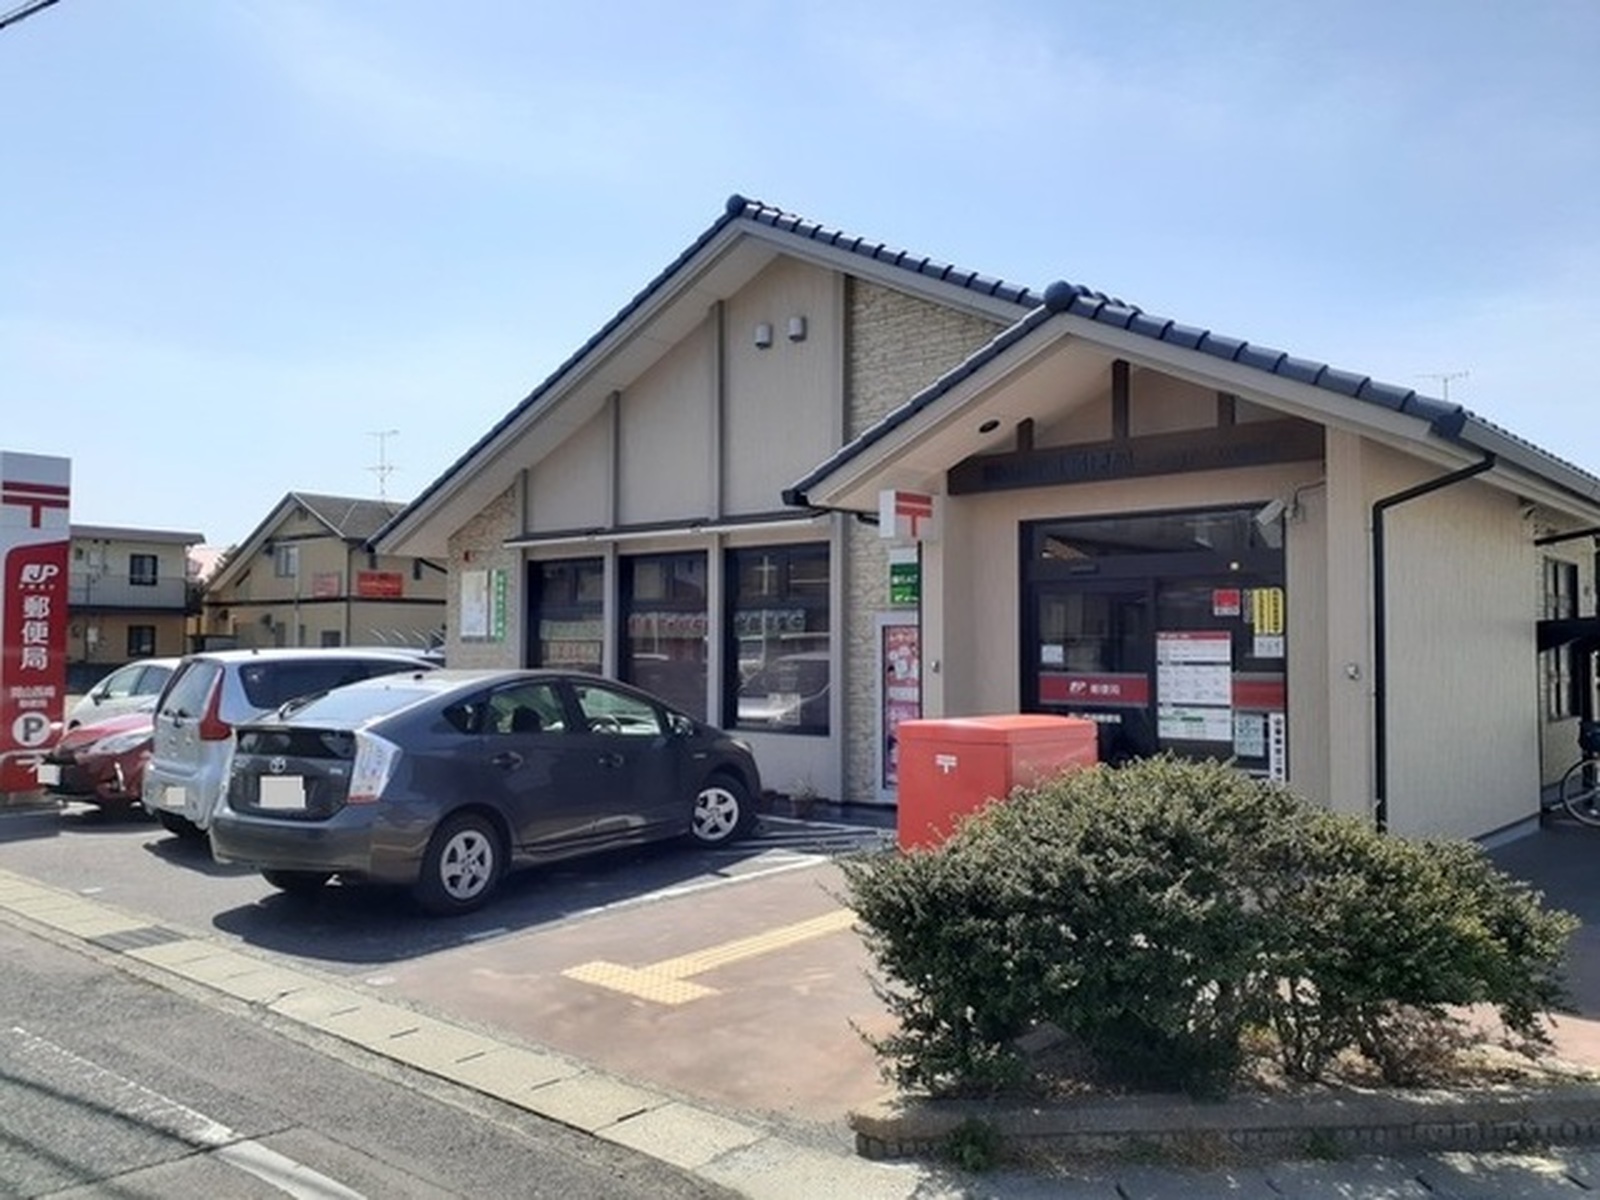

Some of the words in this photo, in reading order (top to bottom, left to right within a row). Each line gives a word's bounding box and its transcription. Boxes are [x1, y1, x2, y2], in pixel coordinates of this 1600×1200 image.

[21, 564, 59, 584] JP
[20, 595, 51, 671] 郵便局
[23, 716, 44, 742] P
